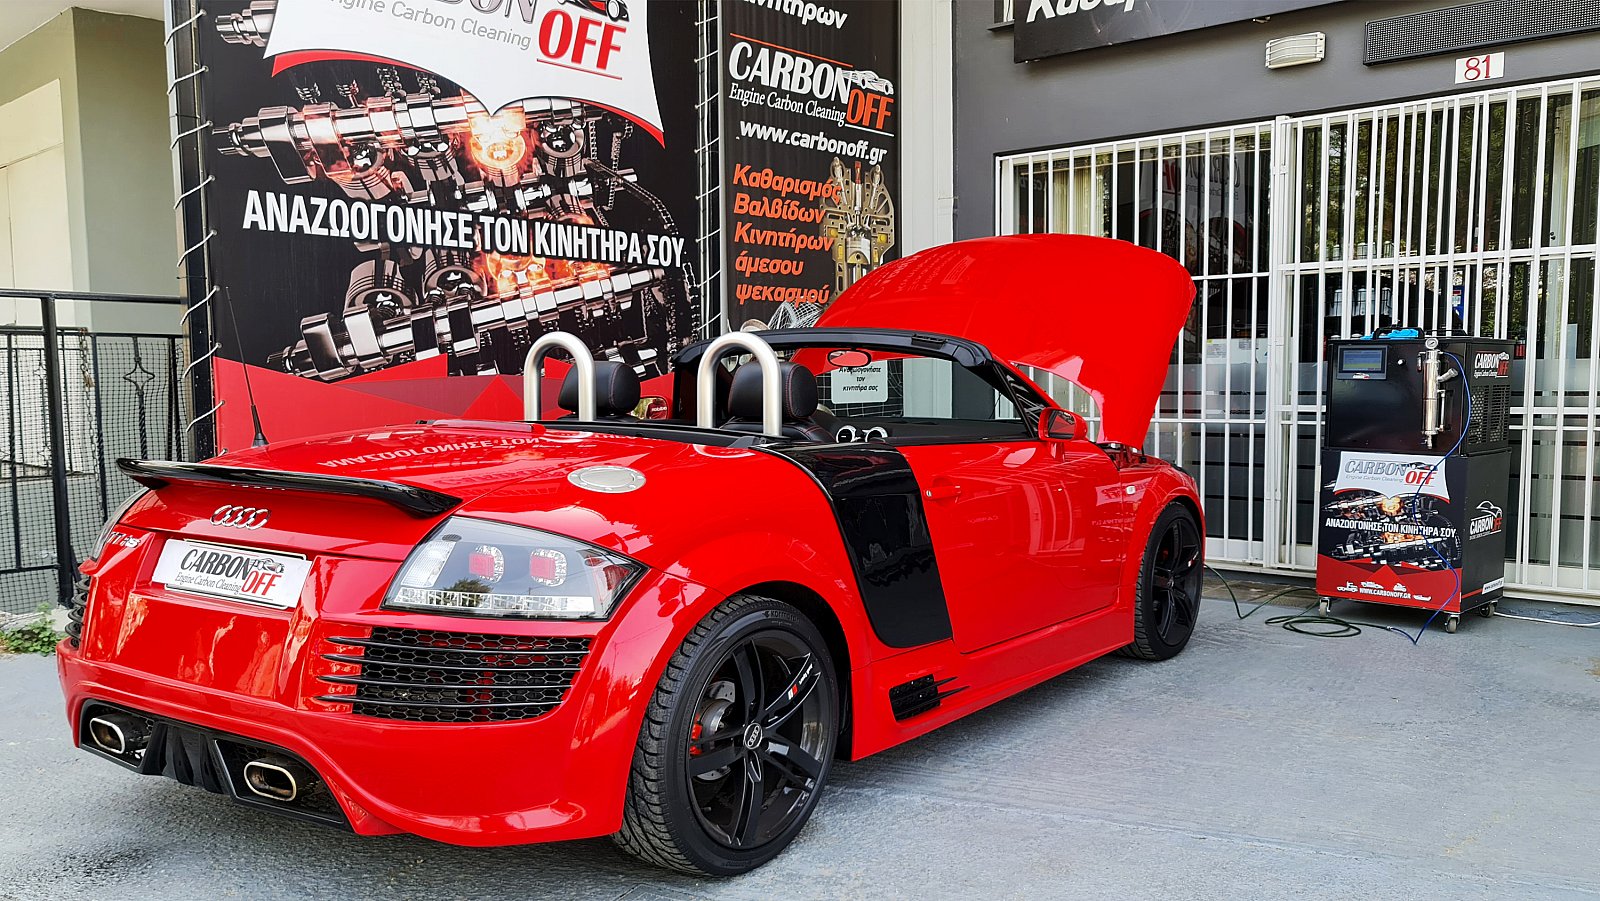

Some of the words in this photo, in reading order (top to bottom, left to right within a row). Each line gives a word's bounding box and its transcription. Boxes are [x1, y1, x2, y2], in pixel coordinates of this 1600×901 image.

[391, 4, 455, 30] Carbon
[461, 18, 531, 50] Cleaning
[538, 8, 627, 70] OFF
[1464, 54, 1490, 80] 81
[728, 41, 851, 104] CARBON
[846, 88, 894, 130] OFF
[729, 82, 765, 107] Engine
[767, 91, 805, 114] Carbon
[805, 100, 846, 127] Cleaning
[740, 120, 888, 166] www.carbonoff.gr
[733, 163, 842, 204] Καθαρισμός
[733, 192, 826, 224] Βαλβίδων
[243, 189, 473, 249] ΑΝΑΖΩΟΓΟΝΗΣΕ
[479, 215, 527, 254] ΤΟΝ
[534, 222, 643, 265] ΚΙΝΗΤΗΡΑ
[647, 234, 684, 268] ΣΟΥ
[734, 222, 835, 252] Κινητήρων
[735, 251, 804, 279] άμεσου
[736, 282, 830, 308] ψεκασμού
[1474, 353, 1499, 369] CARBON
[1344, 460, 1407, 476] CARBON
[1405, 470, 1437, 485] OFF
[1325, 518, 1382, 532] ΑΝΑΖΩΟΓΟΝΗΣΕ
[1383, 522, 1399, 533] ΤΟΝ
[1440, 527, 1457, 538] ΣΟΥ
[1470, 515, 1494, 535] CARBON
[175, 572, 195, 585] Engine
[194, 575, 215, 588] Carbon
[216, 579, 241, 595] Cleaning
[181, 549, 255, 580] CARBON
[241, 570, 282, 596] OFF
[1360, 587, 1411, 599] WWW.CARBONOFF.GR
